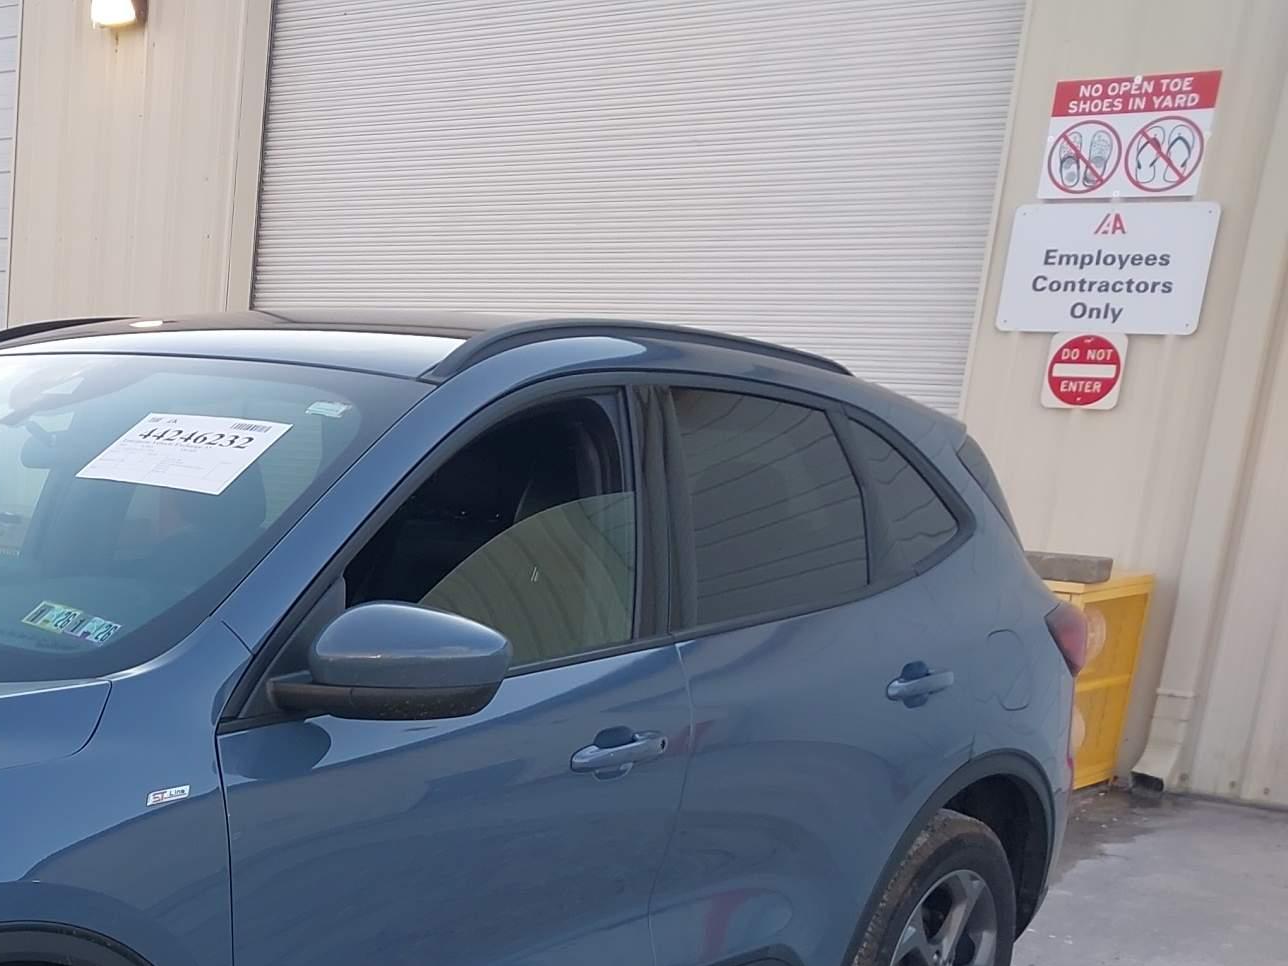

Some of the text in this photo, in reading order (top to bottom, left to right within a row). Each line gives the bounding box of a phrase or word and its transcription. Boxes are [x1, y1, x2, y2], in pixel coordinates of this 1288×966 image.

[1079, 76, 1194, 98] NO OPEN TOE
[1068, 93, 1200, 114] SHOES IN YARD
[1043, 249, 1171, 270] Employees
[1032, 275, 1173, 293] Contractors
[1070, 301, 1124, 324] Only
[1061, 348, 1114, 360] DO NOT
[1060, 380, 1102, 393] ENTER
[138, 427, 255, 449] 44246232
